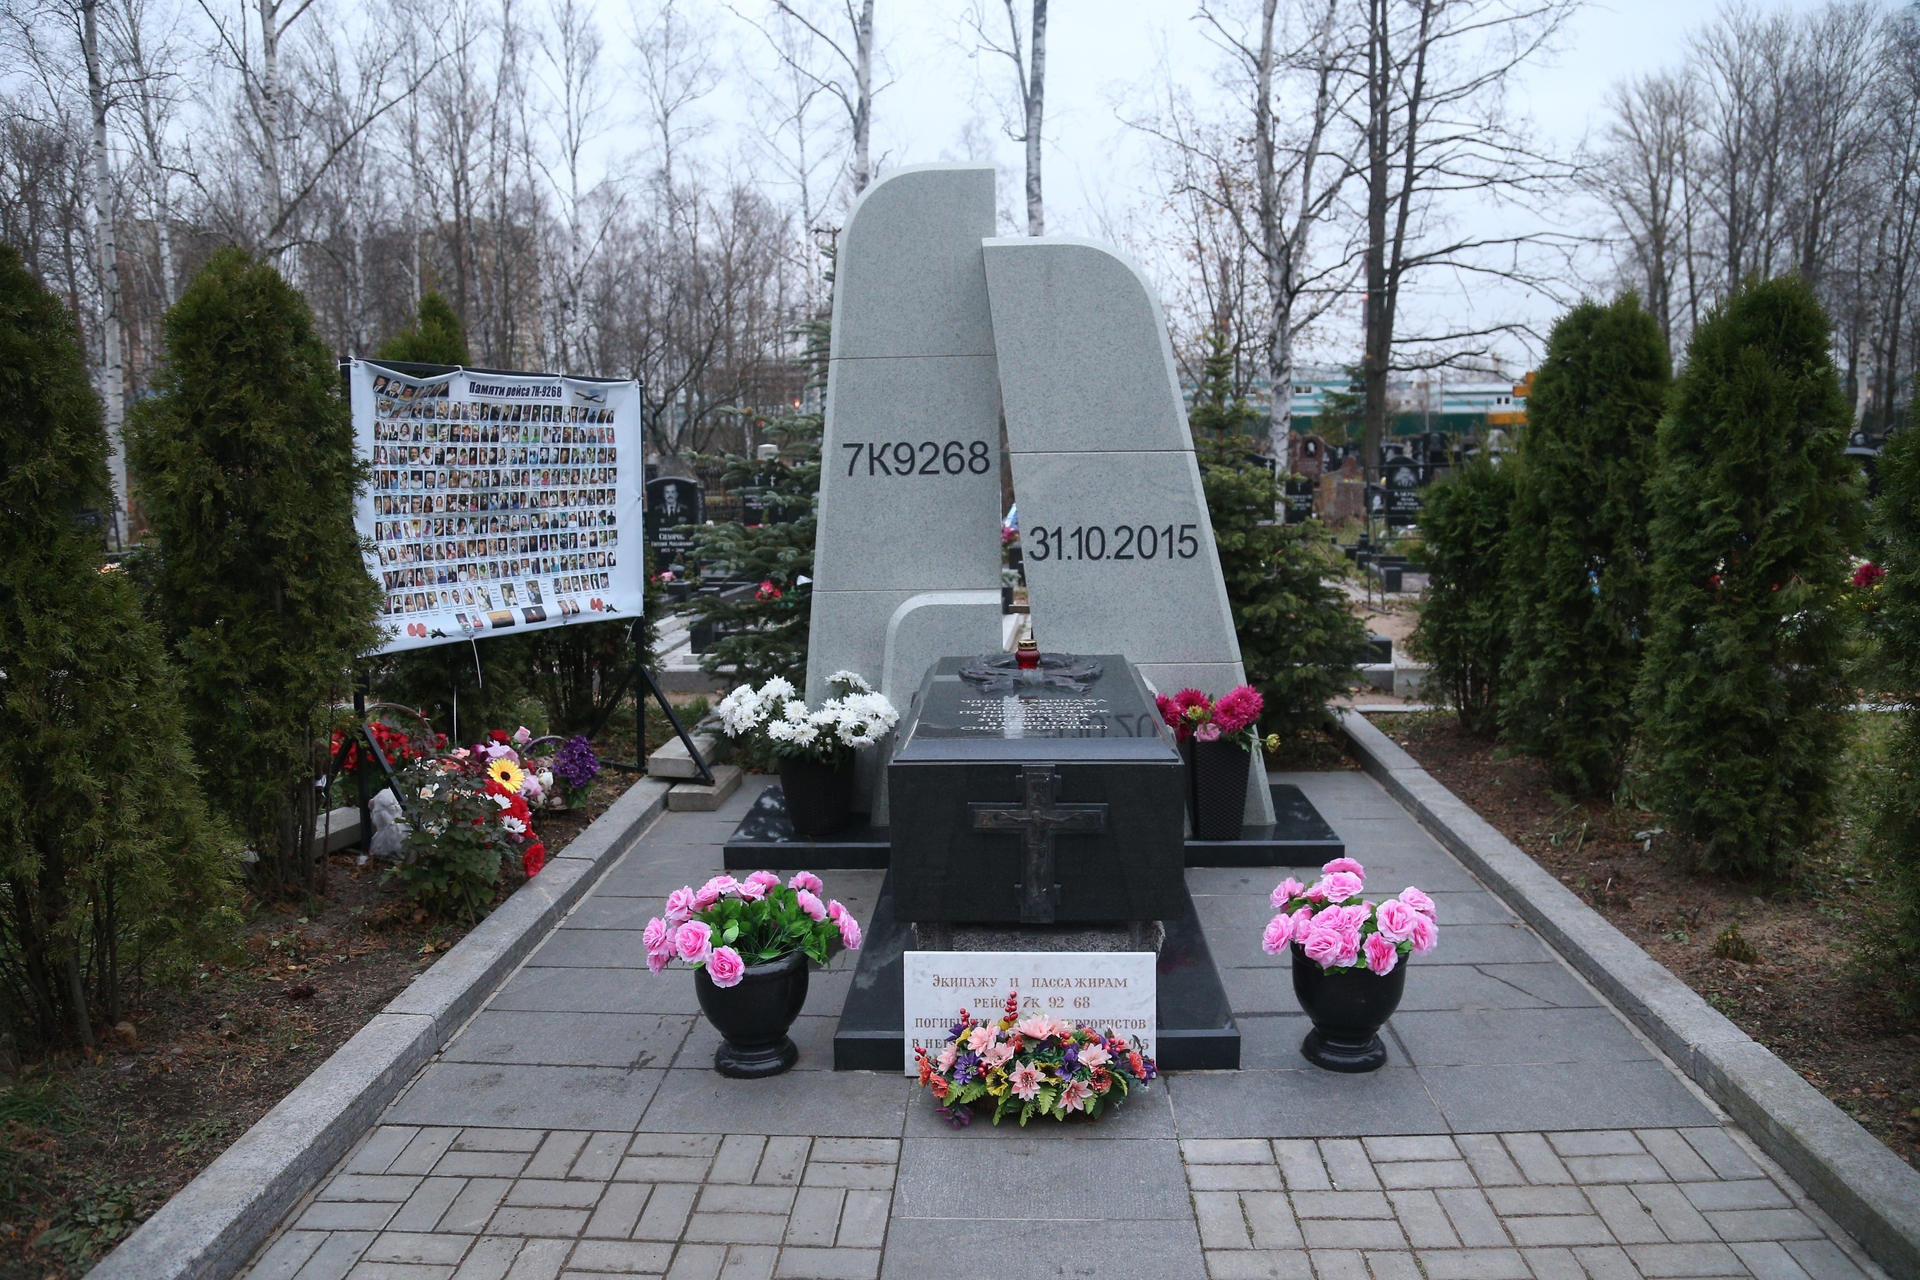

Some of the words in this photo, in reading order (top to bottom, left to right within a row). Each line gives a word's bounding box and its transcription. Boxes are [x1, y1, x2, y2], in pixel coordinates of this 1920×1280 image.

[469, 382, 504, 396] Памяти
[506, 385, 530, 397] рейса
[1028, 524, 1199, 561] 31.10.2015
[932, 974, 998, 988] ЭКИПАЖУ
[1010, 977, 1019, 988] И
[1032, 977, 1128, 988] ПАССАЖИРАМ
[973, 995, 1009, 1009] РЕЙС
[1049, 997, 1065, 1009] 92
[1074, 996, 1091, 1009] 68
[1061, 1019, 1147, 1029] РРОРИСТОВ
[912, 1038, 920, 1048] В
